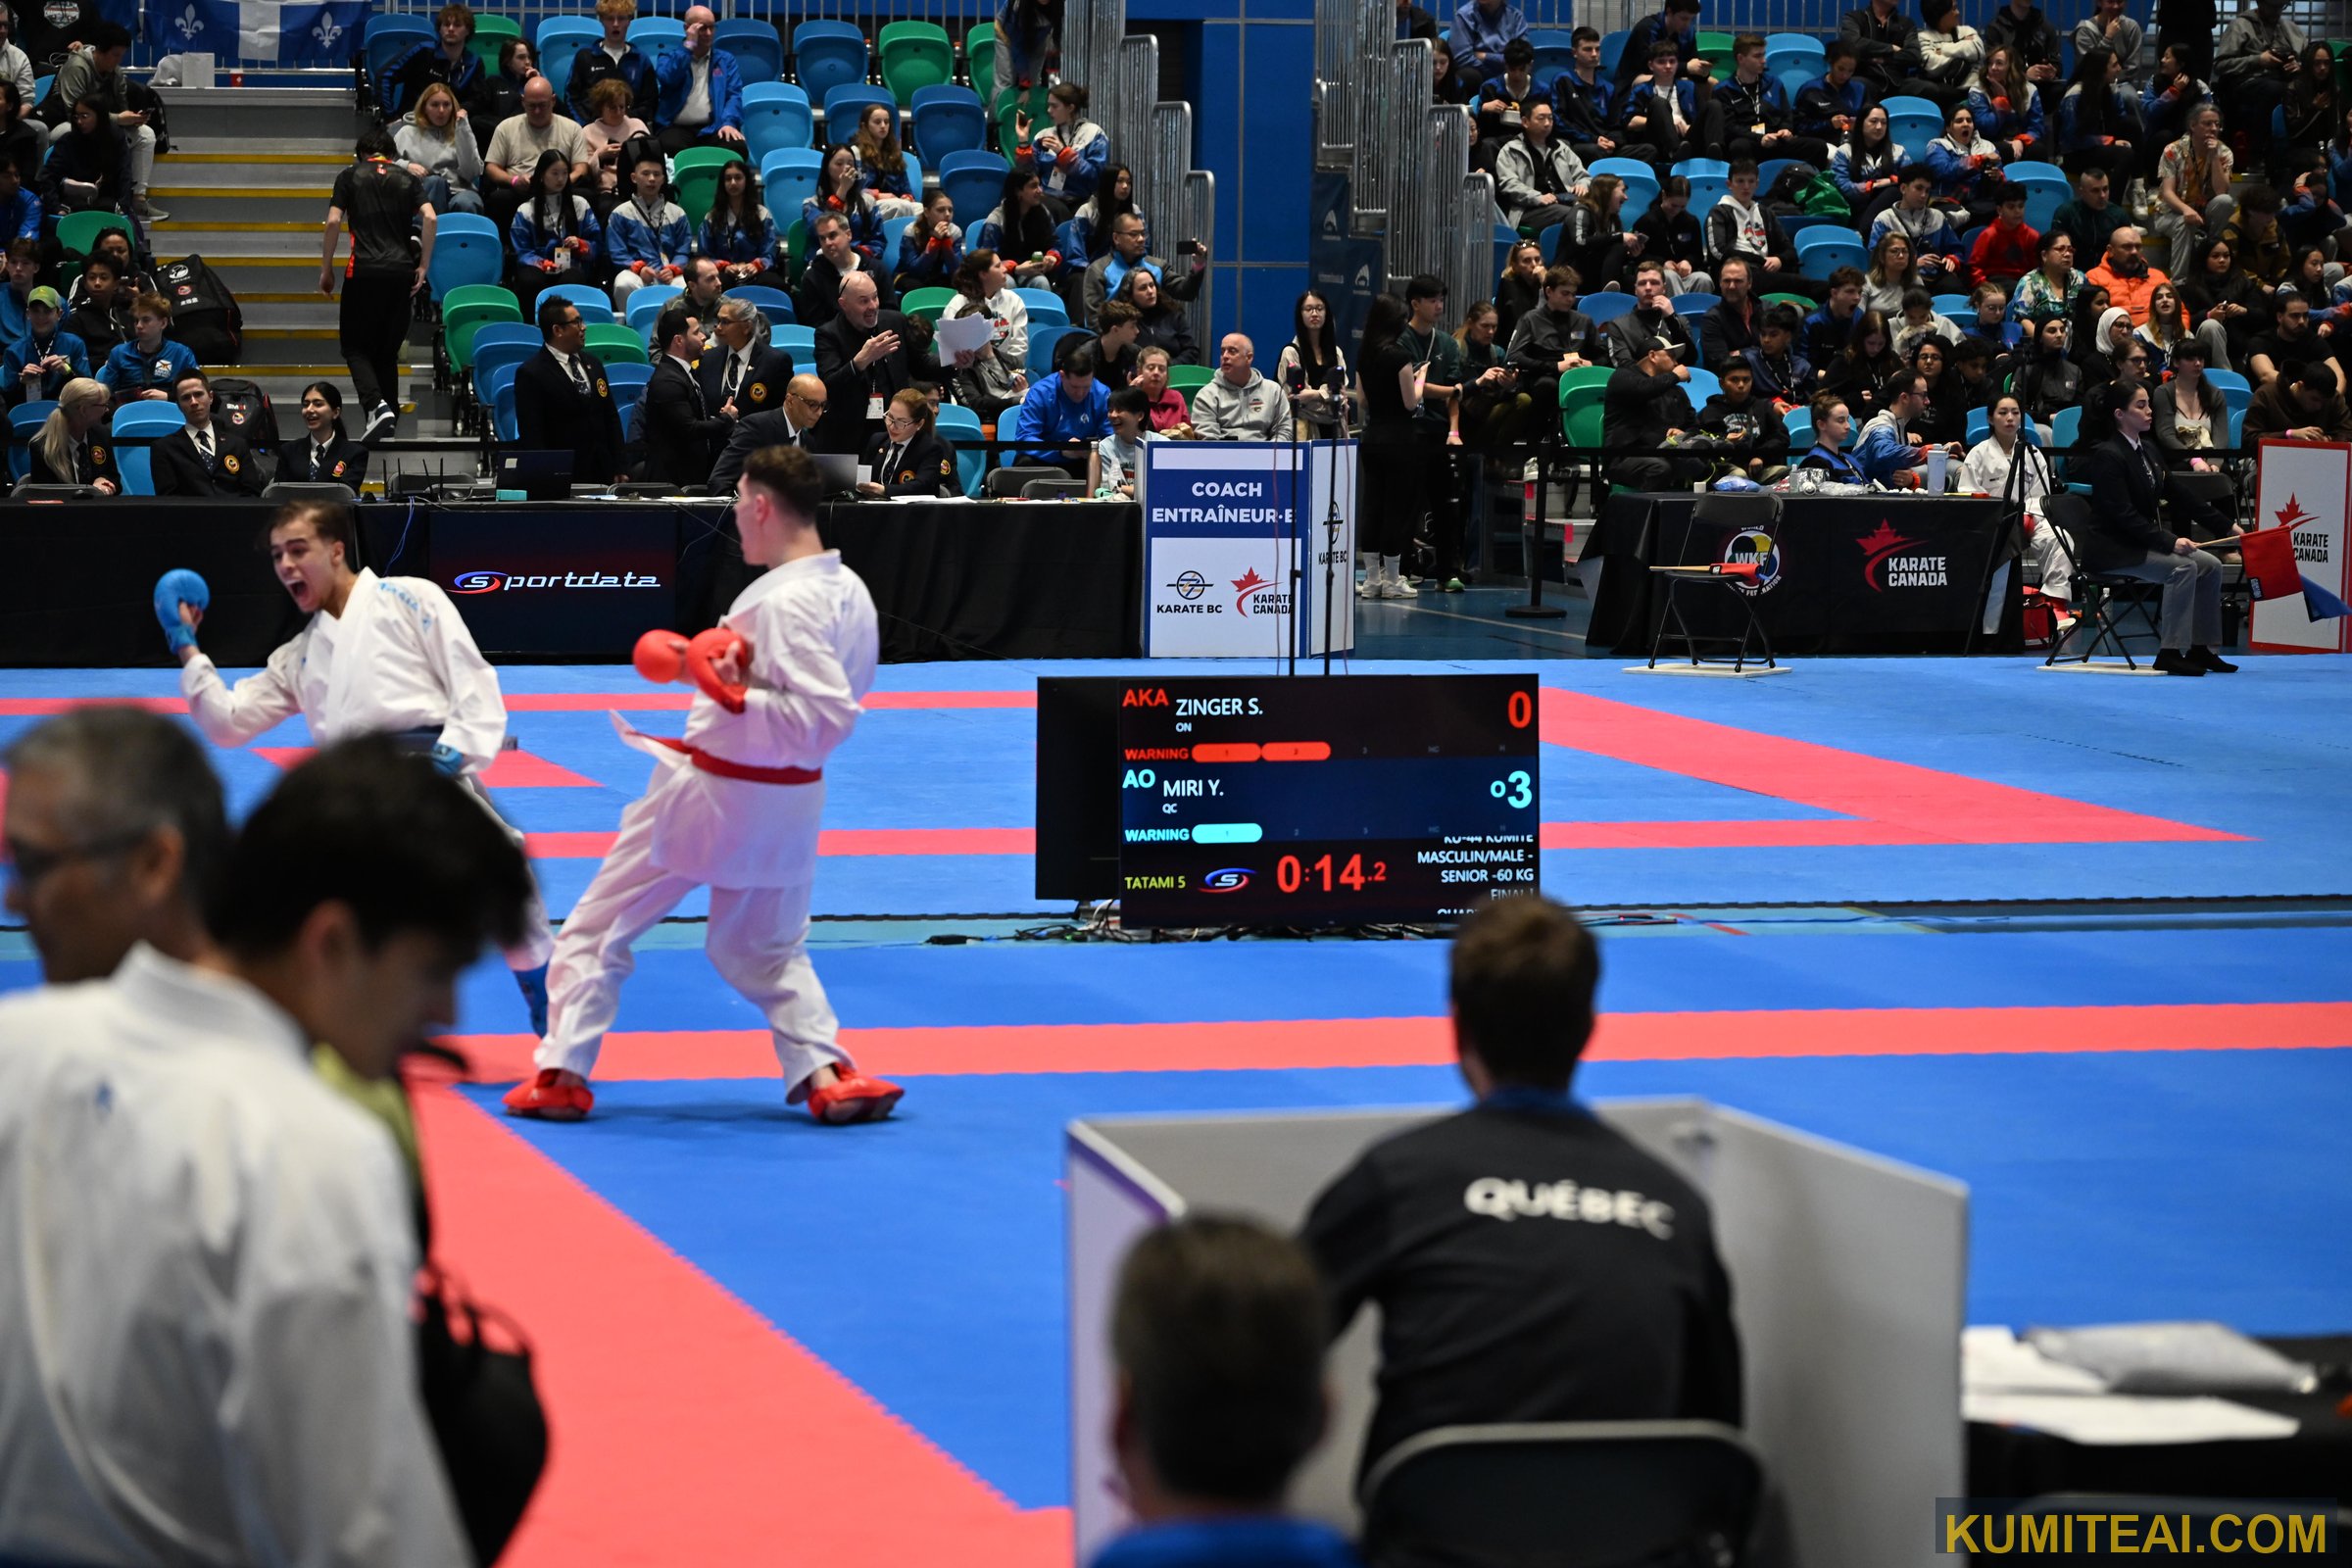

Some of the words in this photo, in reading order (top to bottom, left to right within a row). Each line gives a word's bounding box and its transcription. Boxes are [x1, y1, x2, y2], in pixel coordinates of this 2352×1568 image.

[1192, 482, 1262, 497] COACH
[2293, 532, 2328, 548] KARATE
[1319, 551, 1339, 564] KARTE
[1735, 552, 1767, 566] WKF
[2293, 548, 2328, 563] CANADA
[1888, 557, 1946, 571] KARATE
[1888, 572, 1947, 586] CANADA
[1156, 605, 1203, 613] KARATE
[1206, 605, 1222, 613] BC
[1122, 689, 1168, 707] AKA
[1176, 698, 1243, 716] ZINGER
[1248, 698, 1263, 715] S.
[1507, 691, 1532, 728] 0
[1176, 722, 1192, 732] ON
[1124, 748, 1189, 760] WARNING
[1122, 769, 1155, 788] AO
[1163, 779, 1202, 797] MIRI
[1207, 779, 1224, 797] Y.
[1162, 804, 1177, 814] QC
[1125, 828, 1190, 842] WARNING
[1417, 849, 1525, 864] MASCULIN/MALE
[1125, 876, 1174, 889] TATAMI
[1178, 876, 1186, 889] 5
[1441, 868, 1489, 883] SENIOR
[1492, 868, 1512, 881] -60
[1515, 868, 1534, 881] KG
[1464, 1177, 1675, 1241] QUÉBEC
